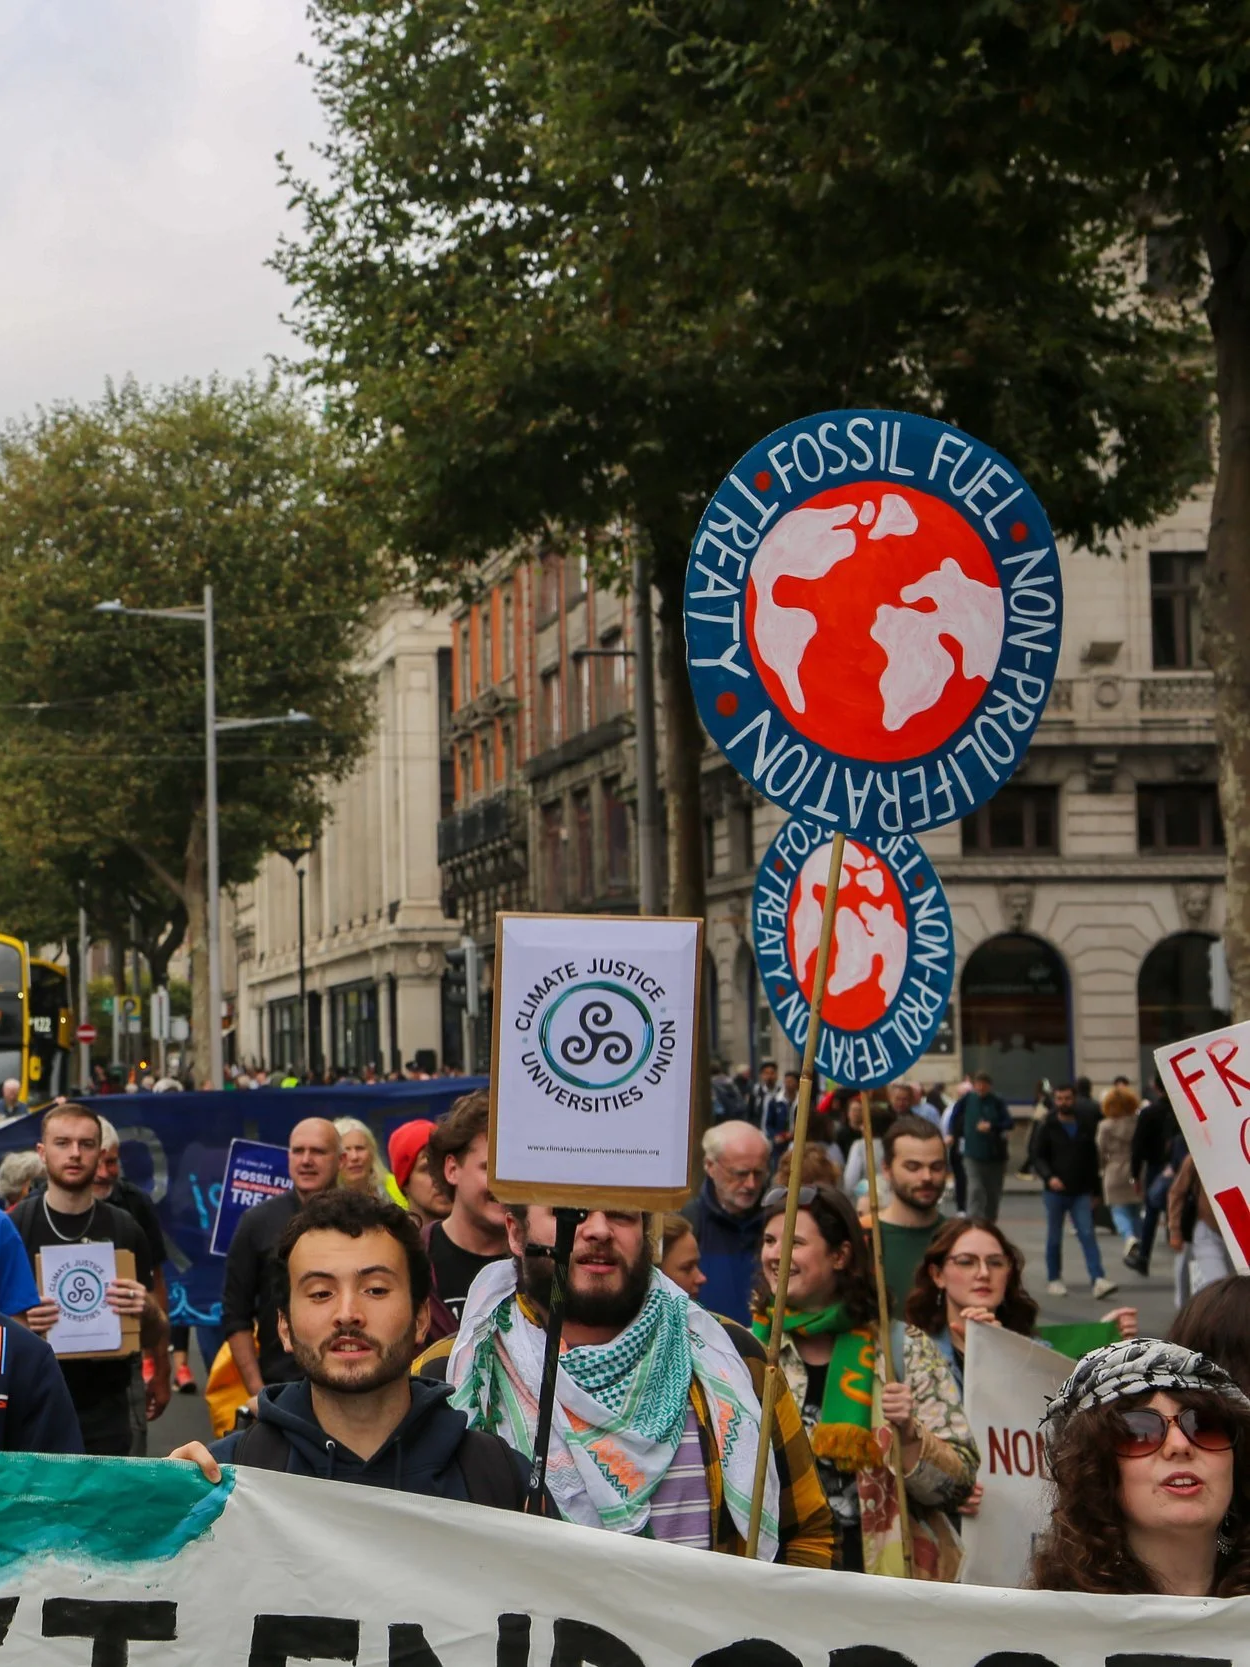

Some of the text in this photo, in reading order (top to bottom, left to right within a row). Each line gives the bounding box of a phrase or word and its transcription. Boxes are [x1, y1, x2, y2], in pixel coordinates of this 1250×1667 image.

[687, 417, 1056, 833] FOSSIL FUEL NON-PROLIFERATION TREATY
[865, 834, 922, 892] UEL
[757, 866, 792, 981] TREATY
[515, 958, 666, 1031] CLIMATE JUSTICE
[521, 1019, 676, 1113] UNIVERSITIES UNION
[231, 1188, 273, 1207] TRE
[233, 1168, 272, 1187] FOSSIL
[49, 1259, 104, 1292] CLIMATE JUSTICE
